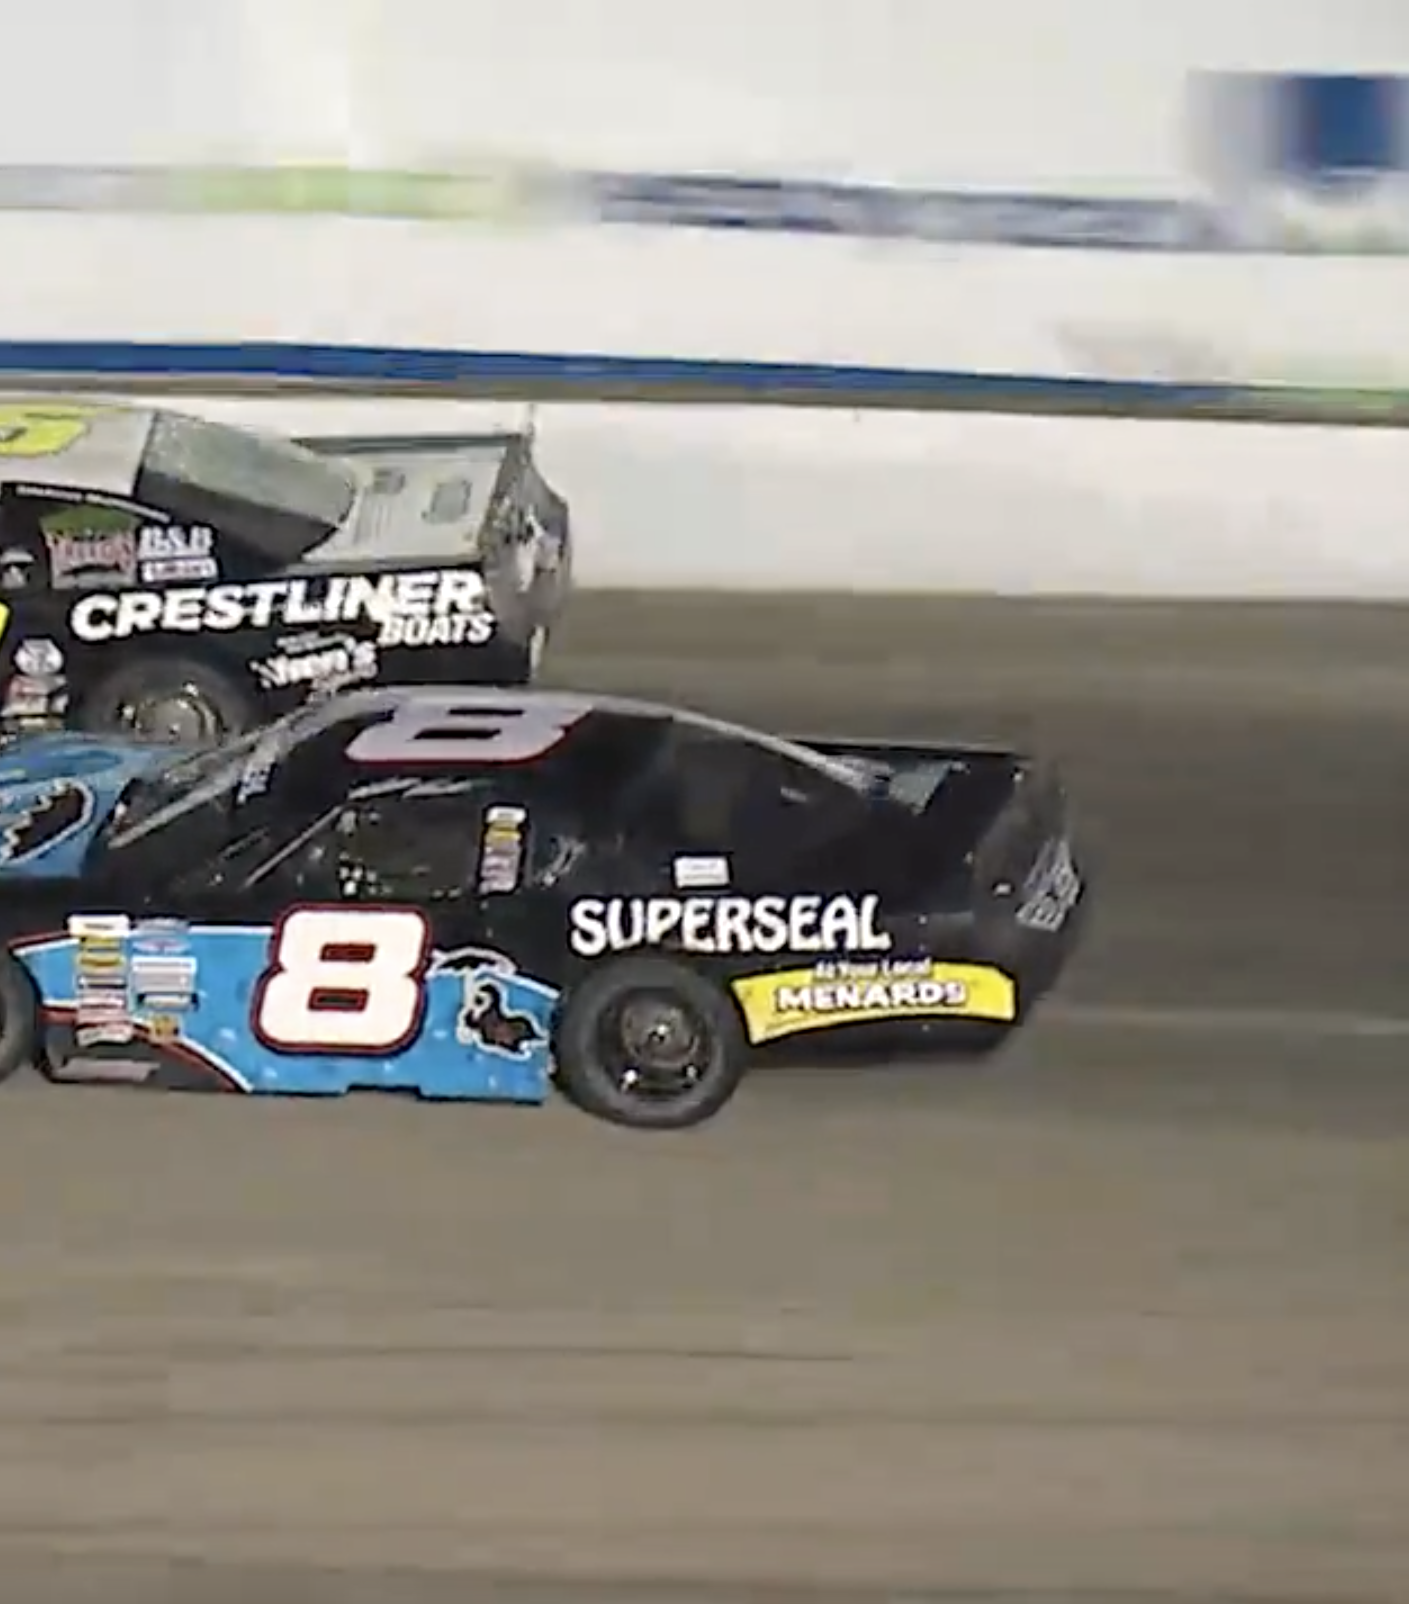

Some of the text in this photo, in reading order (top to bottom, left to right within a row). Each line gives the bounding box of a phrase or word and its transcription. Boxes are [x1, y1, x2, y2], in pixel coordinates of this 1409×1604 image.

[70, 568, 485, 643] CRESTLINER
[376, 612, 496, 646] BOATS
[344, 695, 591, 766] 8
[570, 893, 892, 957] SUPERSEAL
[249, 901, 430, 1057] 8
[776, 980, 967, 1013] MENARDS
